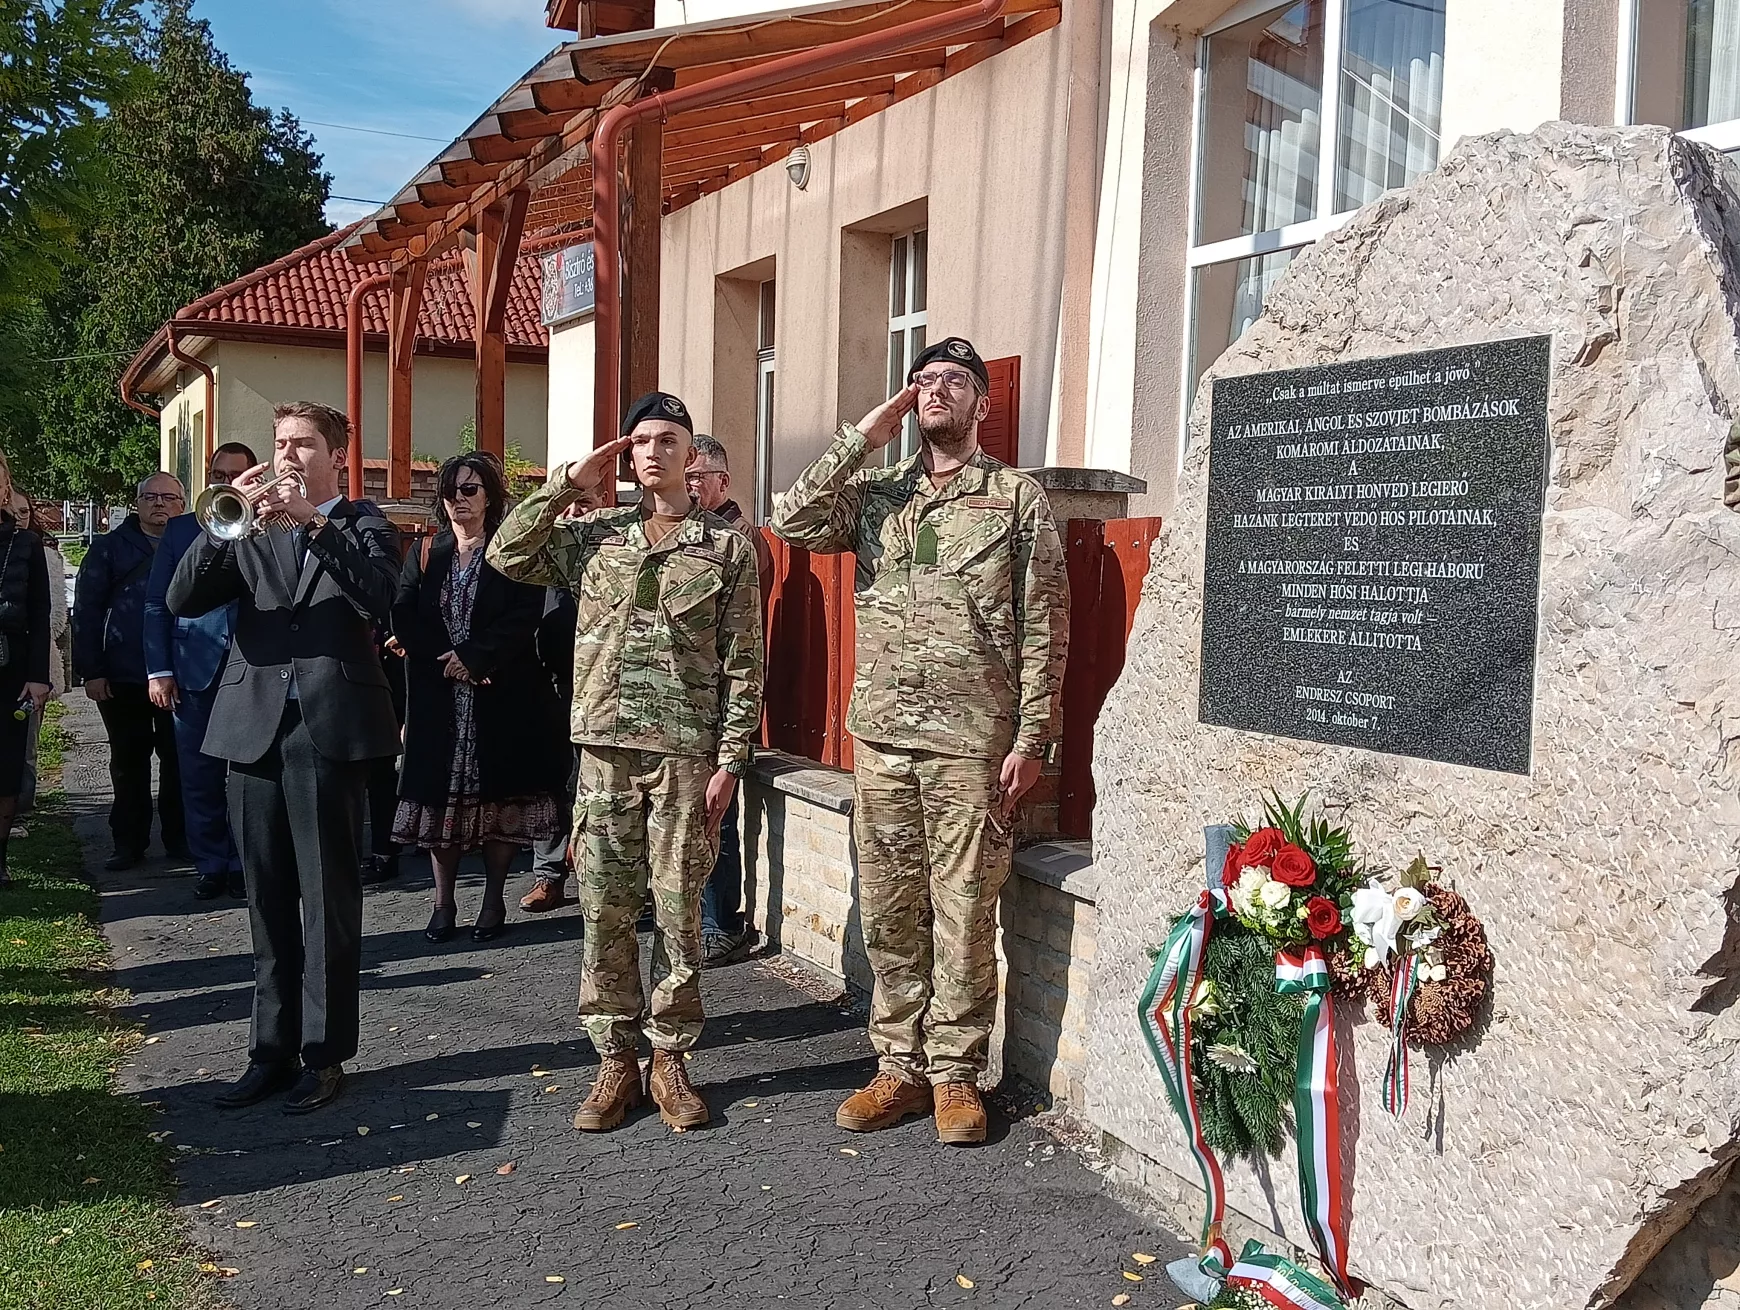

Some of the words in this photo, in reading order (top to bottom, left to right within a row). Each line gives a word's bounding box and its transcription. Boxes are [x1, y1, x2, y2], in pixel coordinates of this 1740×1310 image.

[564, 252, 586, 280] Bisztró
[1298, 387, 1305, 398] a
[1307, 379, 1341, 397] múltat
[1342, 378, 1386, 393] ismerve
[1388, 369, 1432, 391] épülhet
[1434, 371, 1442, 383] a
[1227, 425, 1242, 440] AZ
[1243, 419, 1303, 438] AMERIKAI,
[1304, 415, 1346, 433] ANGOL
[1347, 407, 1363, 429] ÉS
[1365, 408, 1421, 427] SZOVJET
[1422, 394, 1520, 423] BOMBÁZÁSOK
[1276, 436, 1340, 460] KOMÁROMI
[1347, 460, 1359, 476] A
[1256, 486, 1302, 503] MAGYAR
[1304, 477, 1354, 501] KIRÁLYI
[1356, 474, 1409, 499] HONVÉD
[1410, 471, 1469, 497] LÉGIERŐ
[1233, 505, 1280, 528] HAZÁNK
[1281, 503, 1342, 527] LÉGTERÉT
[1344, 502, 1378, 526] VÉDŐ
[1379, 501, 1406, 526] HŐS
[1407, 500, 1498, 528] PILÓTÁINAK,
[1344, 529, 1360, 551] ÉS
[1238, 559, 1246, 574] A
[1247, 552, 1335, 575] MAGYARORSZÁG
[1336, 559, 1391, 576] FELETTI
[1393, 554, 1424, 577] LÉGI
[1426, 554, 1486, 580] HÁBORÚ
[1281, 582, 1328, 599] MINDEN
[1329, 577, 1358, 600] HŐSI
[1360, 584, 1430, 605] HALOTTJA
[1284, 600, 1327, 622] bármely
[1328, 606, 1368, 621] nemzet
[1370, 607, 1399, 626] tagja
[1401, 608, 1424, 625] volt
[1282, 621, 1347, 645] EMLÉKÉRE
[1348, 623, 1422, 652] ÁLLÍTOTTA
[1336, 669, 1353, 684] AZ
[1295, 685, 1343, 704] ENDRESZ
[1344, 691, 1397, 710] CSOPORT
[1305, 707, 1329, 724] 2014.
[1331, 710, 1370, 729] október
[1371, 716, 1381, 731] 7.
